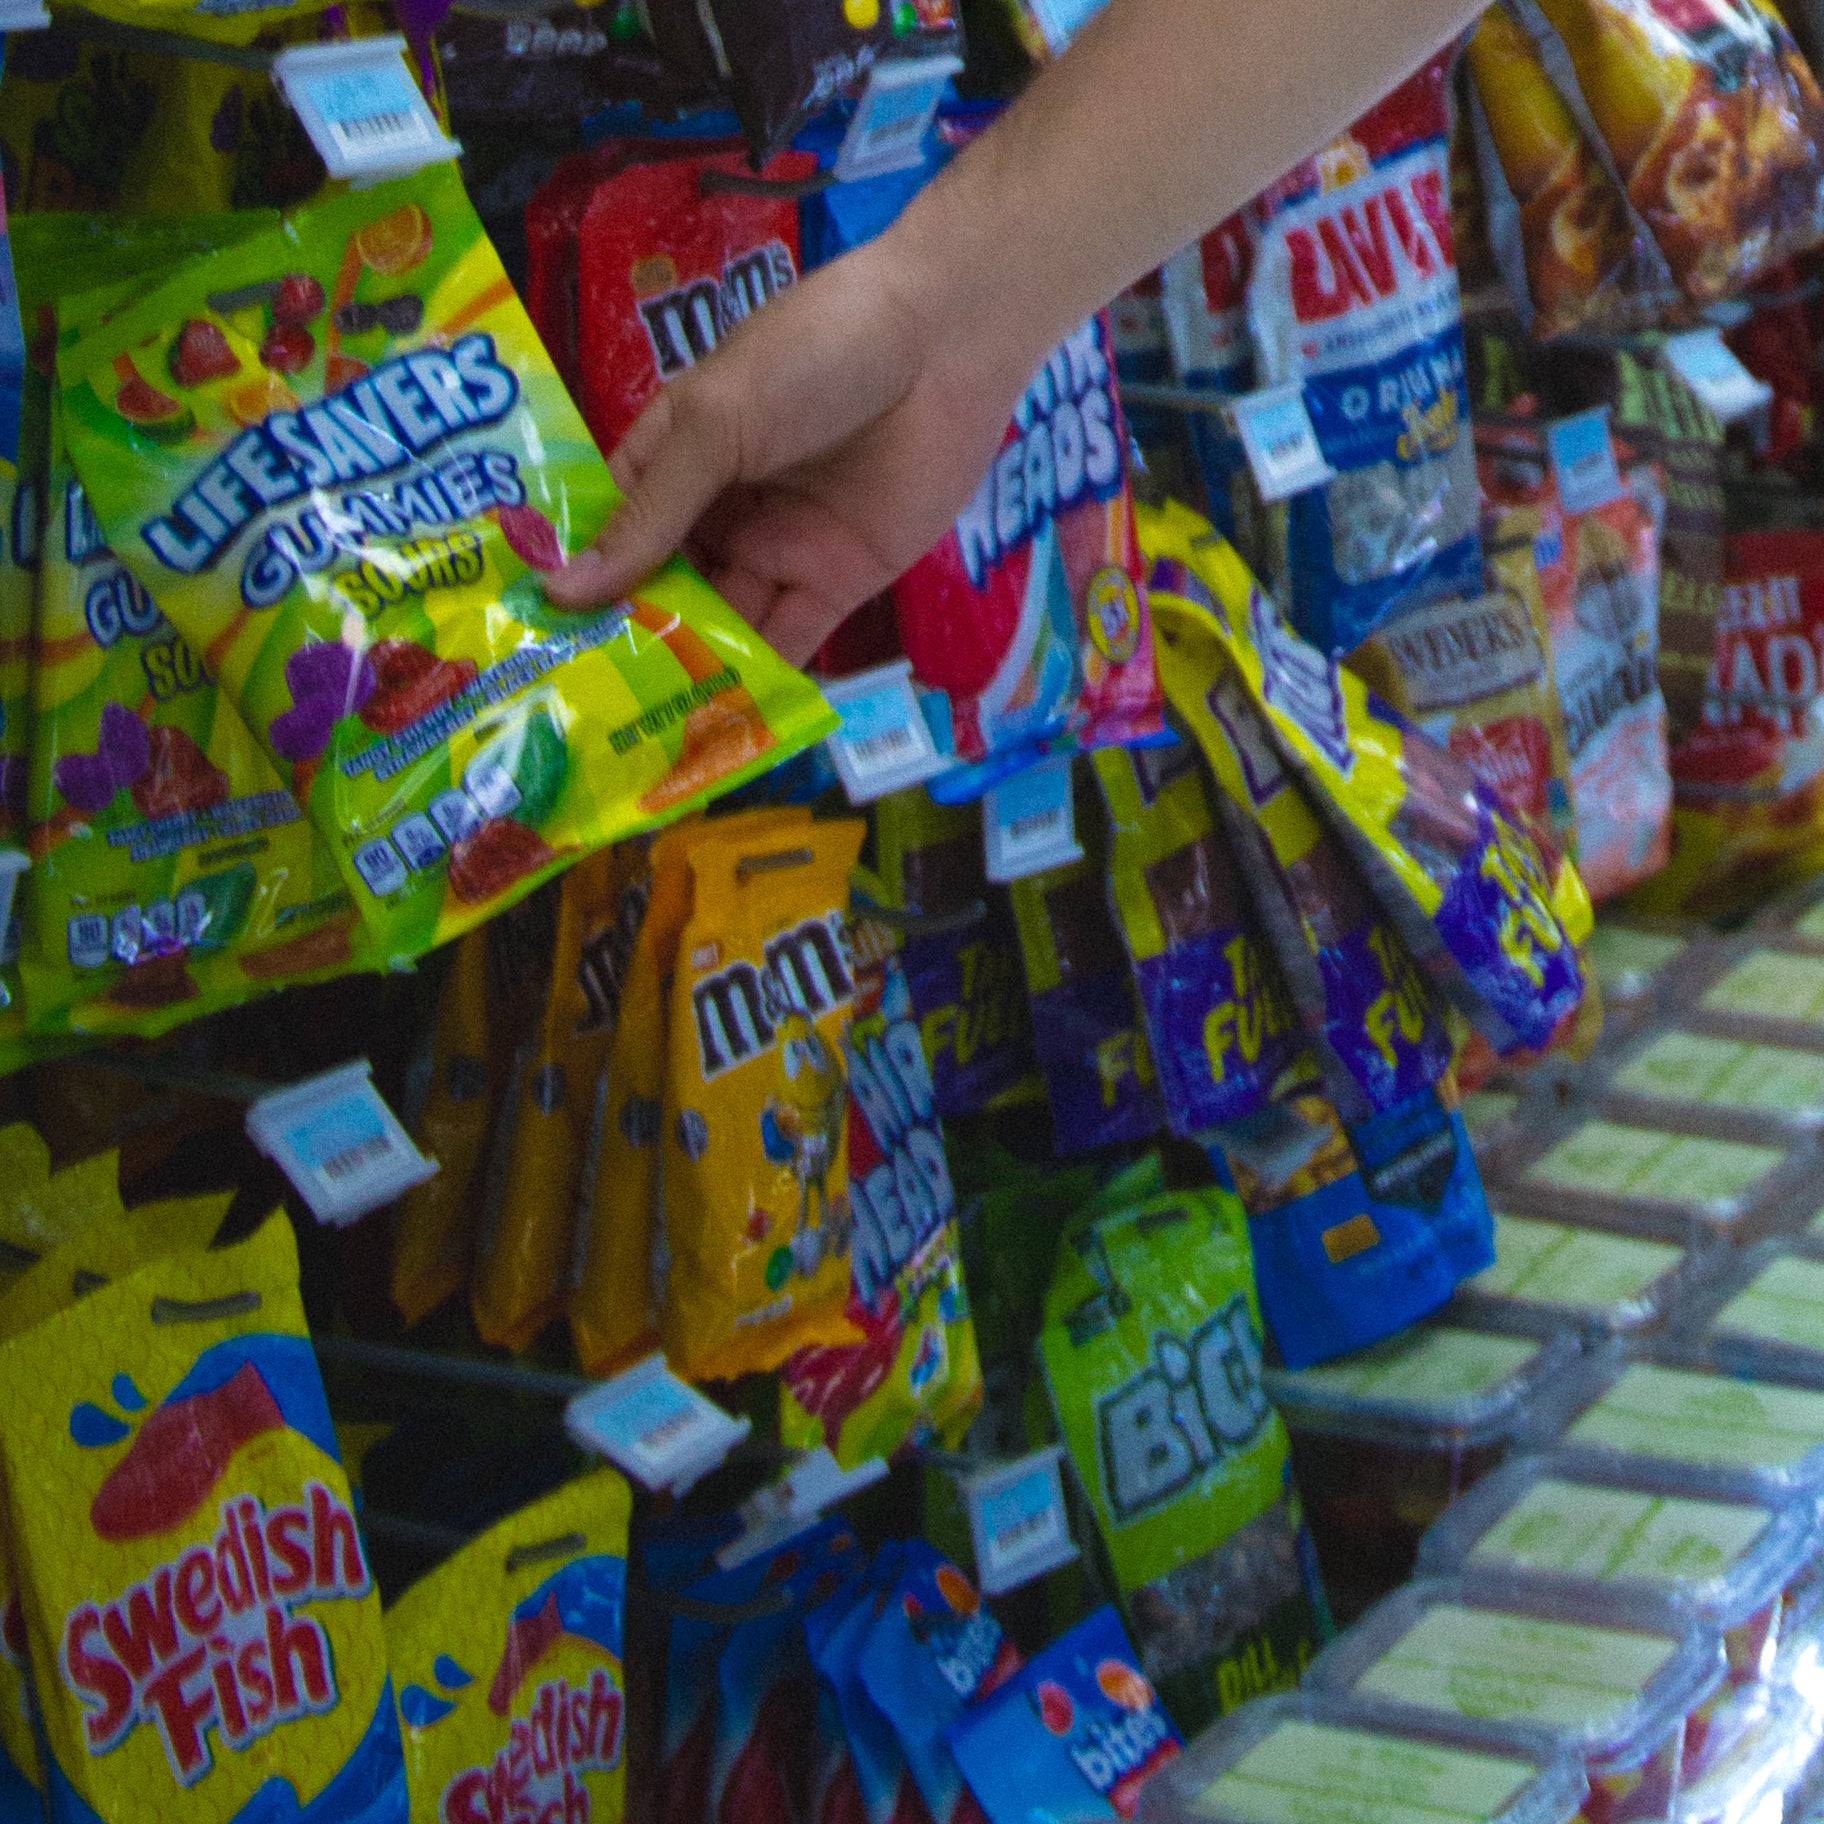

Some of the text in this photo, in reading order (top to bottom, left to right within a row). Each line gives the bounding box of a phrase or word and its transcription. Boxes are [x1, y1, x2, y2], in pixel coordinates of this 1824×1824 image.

[241, 451, 527, 609] GUMMIES
[954, 387, 1117, 589] HEADS
[63, 1481, 371, 1750] Swedish
[142, 1604, 337, 1786] Fish
